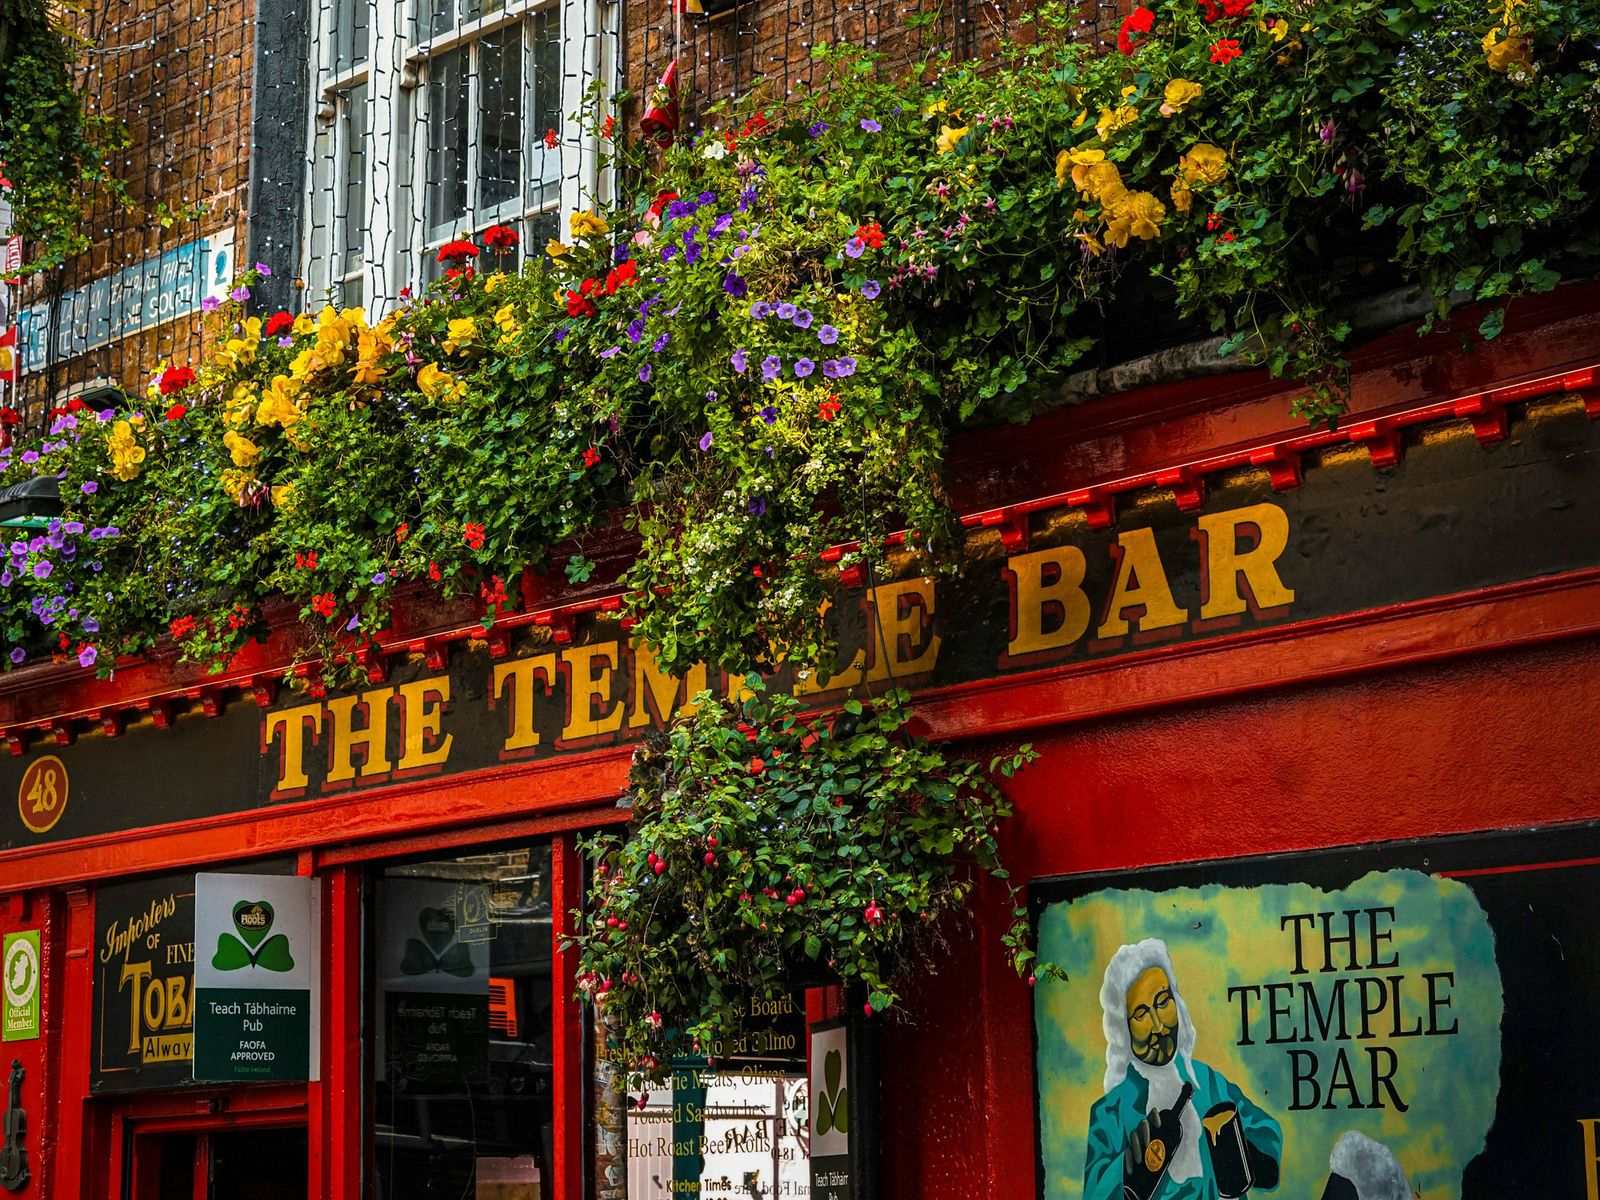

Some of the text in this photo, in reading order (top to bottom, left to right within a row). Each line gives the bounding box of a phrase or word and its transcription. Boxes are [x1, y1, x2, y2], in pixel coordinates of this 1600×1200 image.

[215, 250, 228, 286] 2
[148, 281, 196, 319] SOUTH
[266, 675, 453, 792] THE
[1007, 501, 1296, 657] BAR
[27, 768, 57, 814] 48
[100, 892, 176, 964] Importers
[1280, 905, 1400, 976] THE
[146, 933, 161, 950] OF
[8, 1005, 31, 1019] Official
[209, 1001, 297, 1016] Teach Tábhairne
[751, 992, 793, 1017] Board
[1227, 971, 1460, 1047] TEMPLE
[7, 1018, 33, 1030] Member
[243, 1019, 264, 1032] Pub
[230, 1051, 276, 1061] APPROVED
[239, 1040, 267, 1050] FAOFA
[596, 1042, 631, 1062] Fresh
[751, 1031, 796, 1052] Slmo
[692, 1068, 737, 1090] Meats,
[741, 1064, 786, 1086] Olives
[1286, 1045, 1410, 1114] BAR
[634, 1098, 767, 1125] Toasted Sandwiches
[628, 1138, 653, 1158] Hot
[657, 1137, 695, 1157] Roast
[733, 1133, 771, 1154] Rolls
[666, 1178, 732, 1193] Kitchen Times
